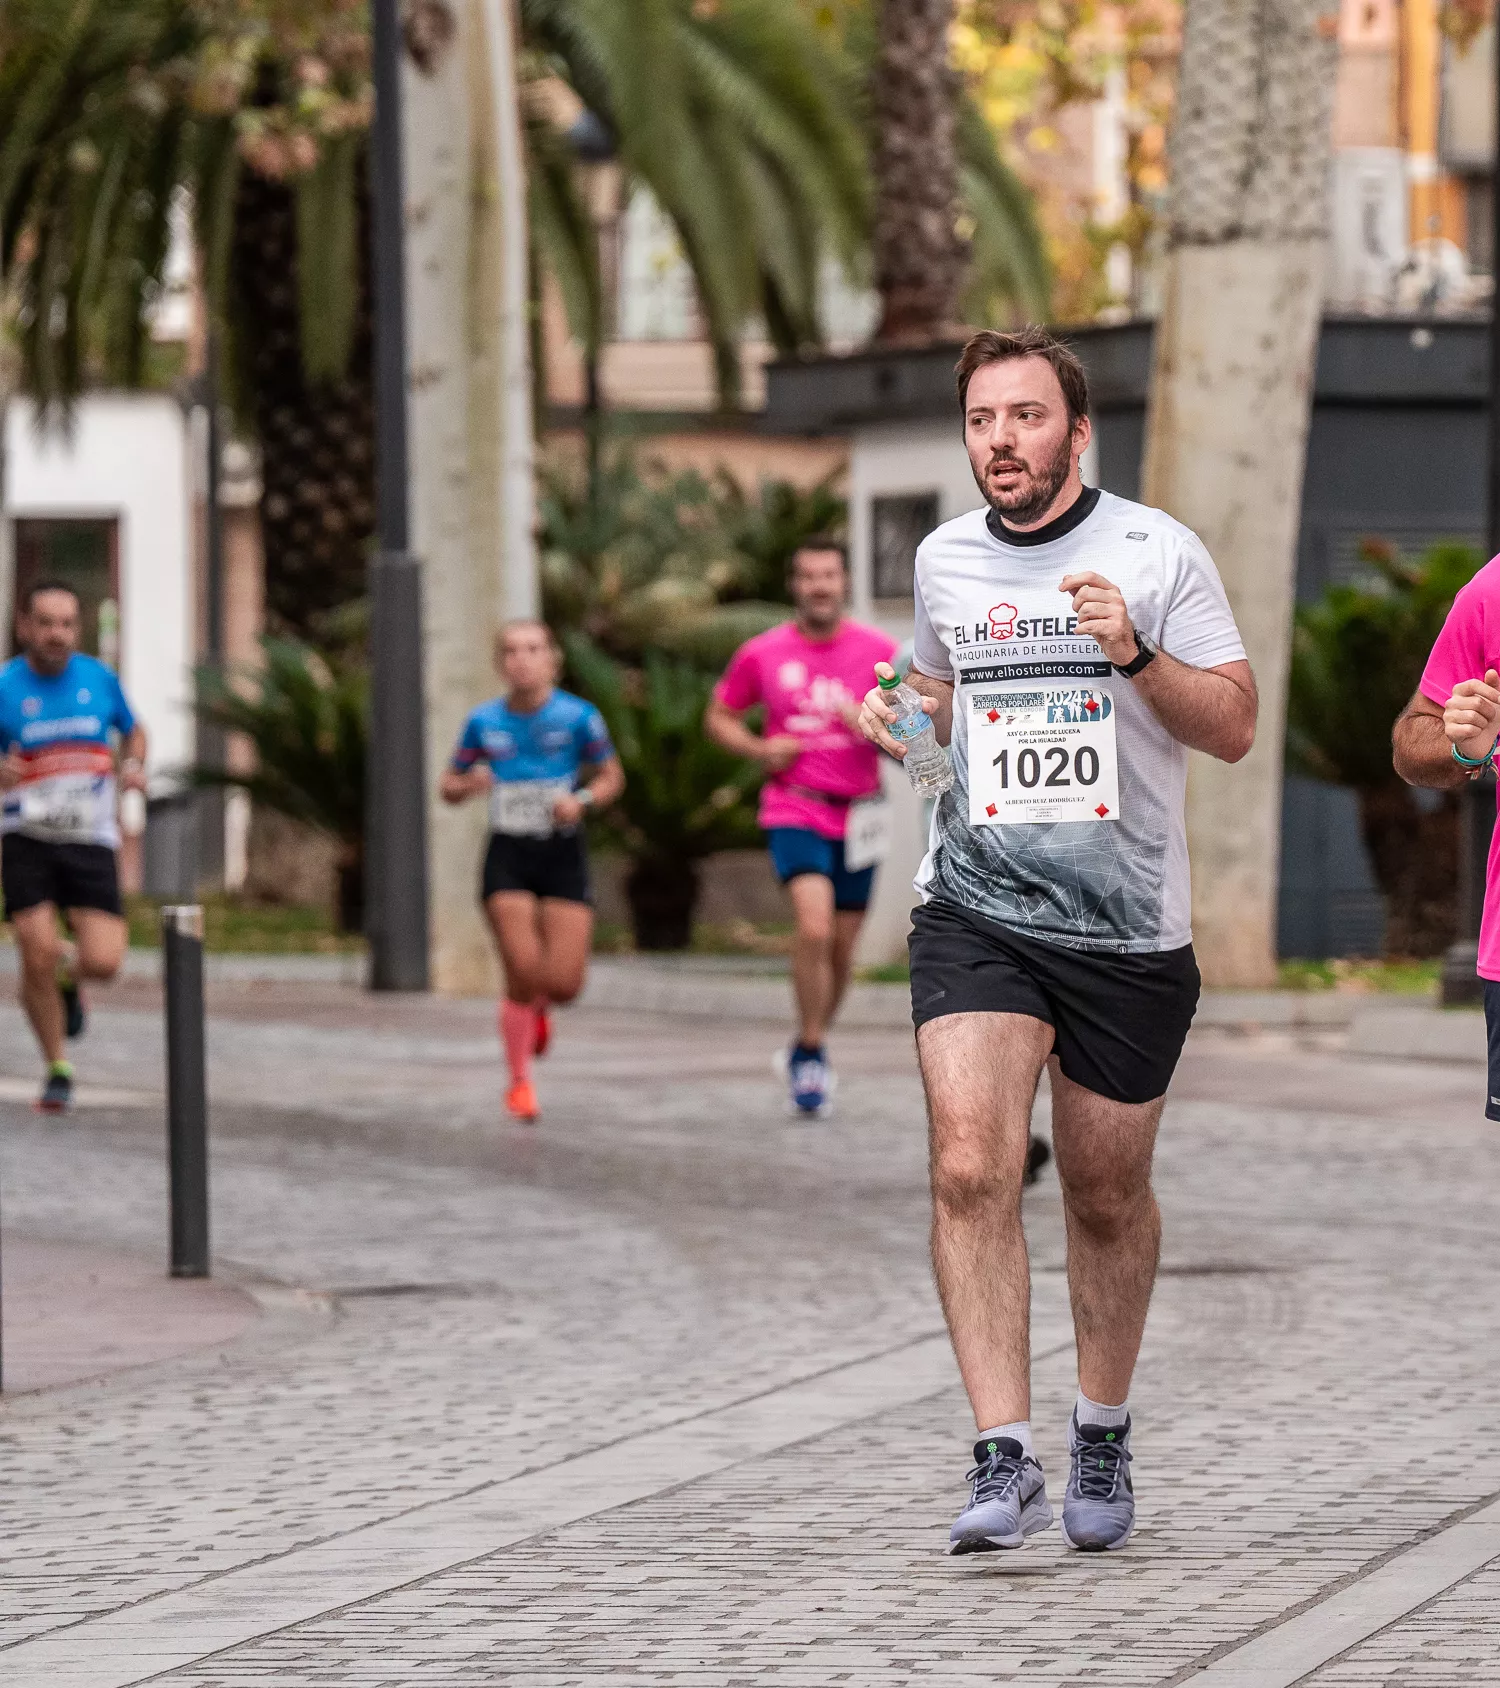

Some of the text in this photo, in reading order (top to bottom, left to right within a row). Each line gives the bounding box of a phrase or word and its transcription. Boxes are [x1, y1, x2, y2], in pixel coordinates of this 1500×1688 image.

[955, 626, 970, 645] EL
[957, 645, 1019, 662] MAQUINARIA
[1023, 645, 1037, 656] DE
[968, 664, 1096, 680] www.elhostelero.com
[972, 694, 999, 702] CIRCUITO
[1000, 692, 1036, 701] PROVINCIAL
[972, 699, 1046, 709] CARRERAS POPULARES
[1045, 690, 1082, 707] 2024
[992, 746, 1100, 789] 1020
